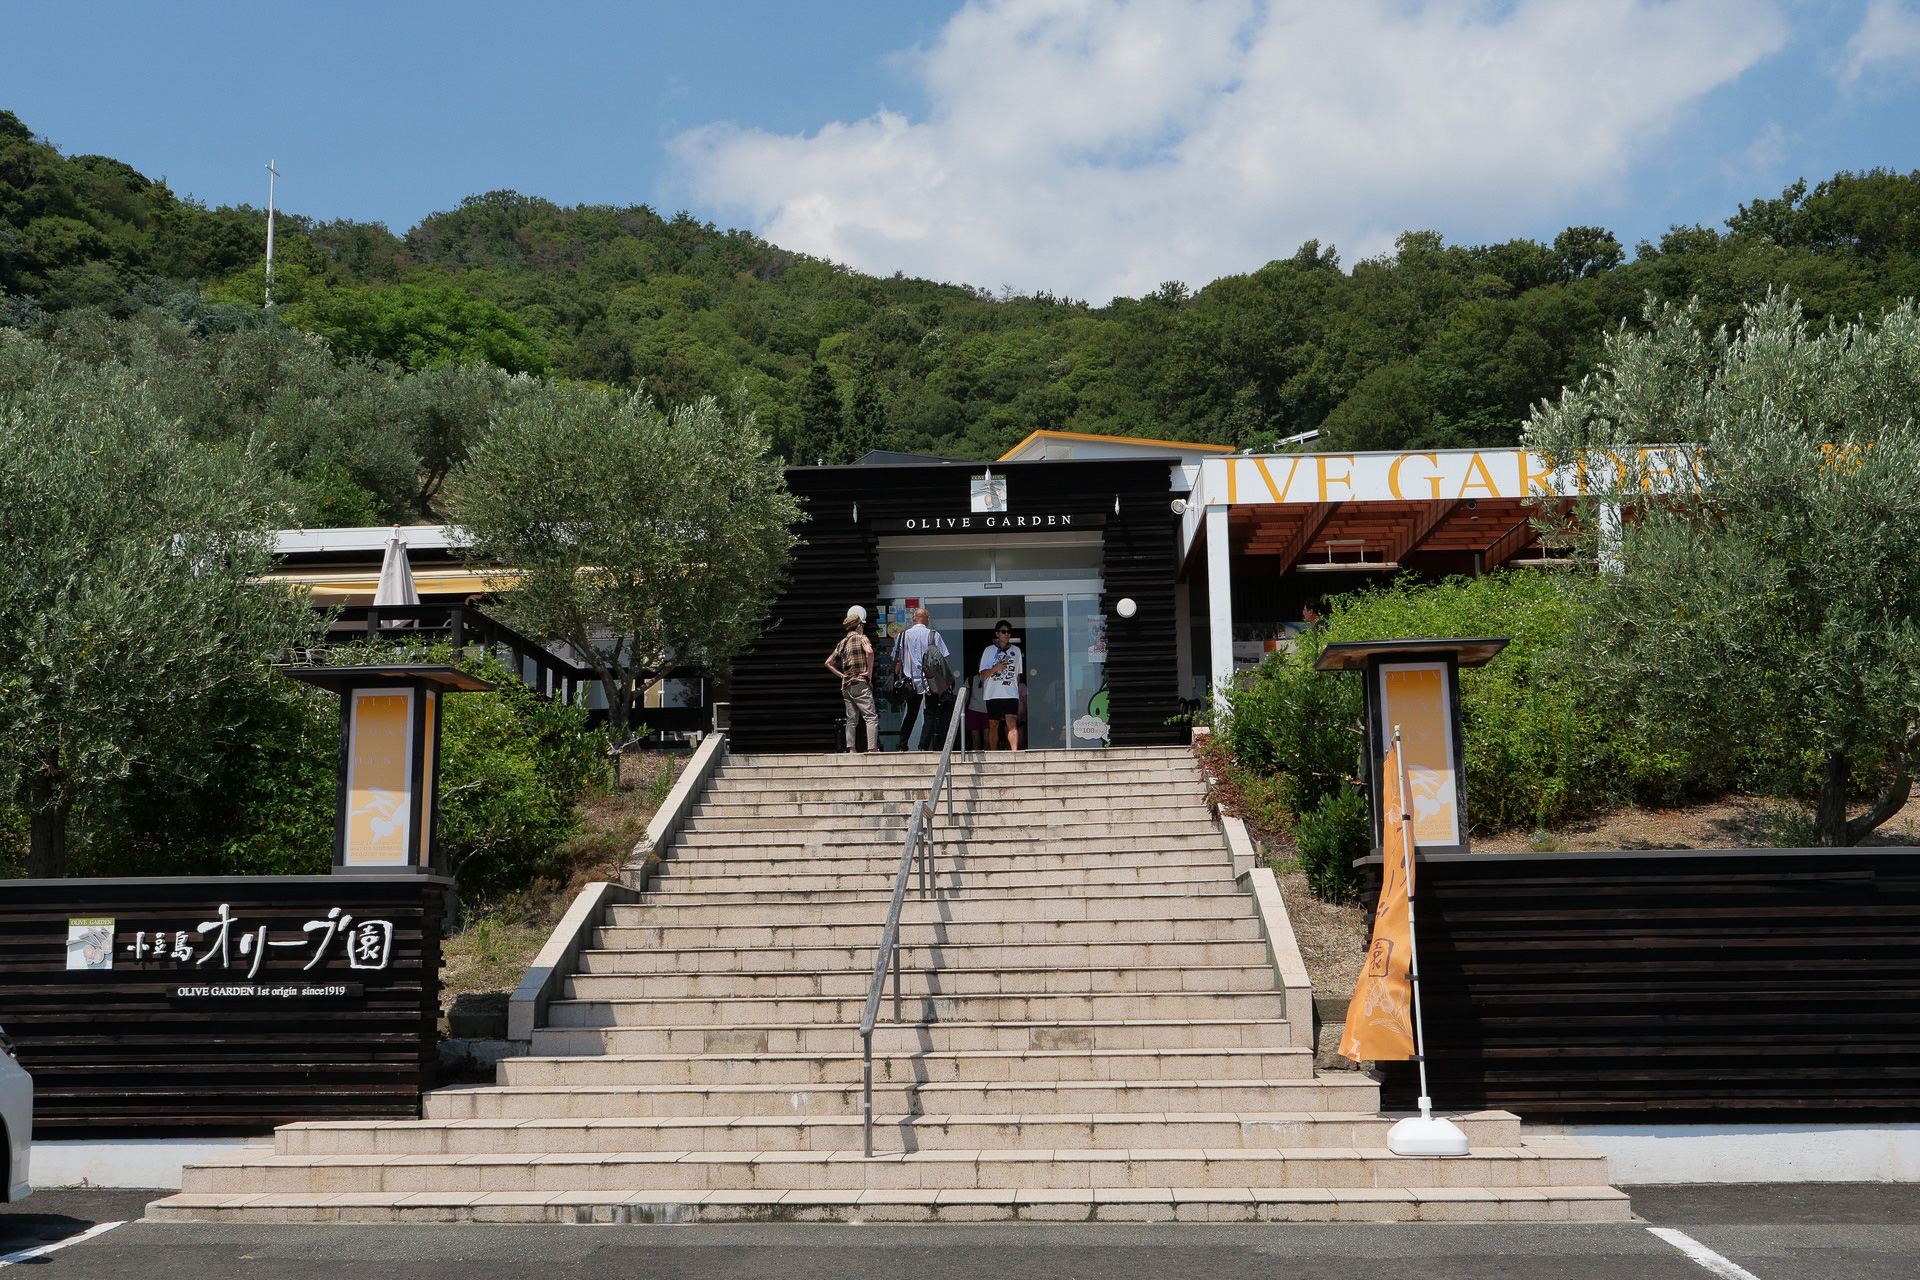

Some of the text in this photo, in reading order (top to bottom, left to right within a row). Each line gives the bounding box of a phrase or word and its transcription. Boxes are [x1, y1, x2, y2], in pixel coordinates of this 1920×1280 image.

[1211, 455, 1355, 505] IVE
[906, 515, 1072, 529] OLIVE GARDEN
[177, 986, 346, 998] OLIVE GARDEN 1st origin since1919
